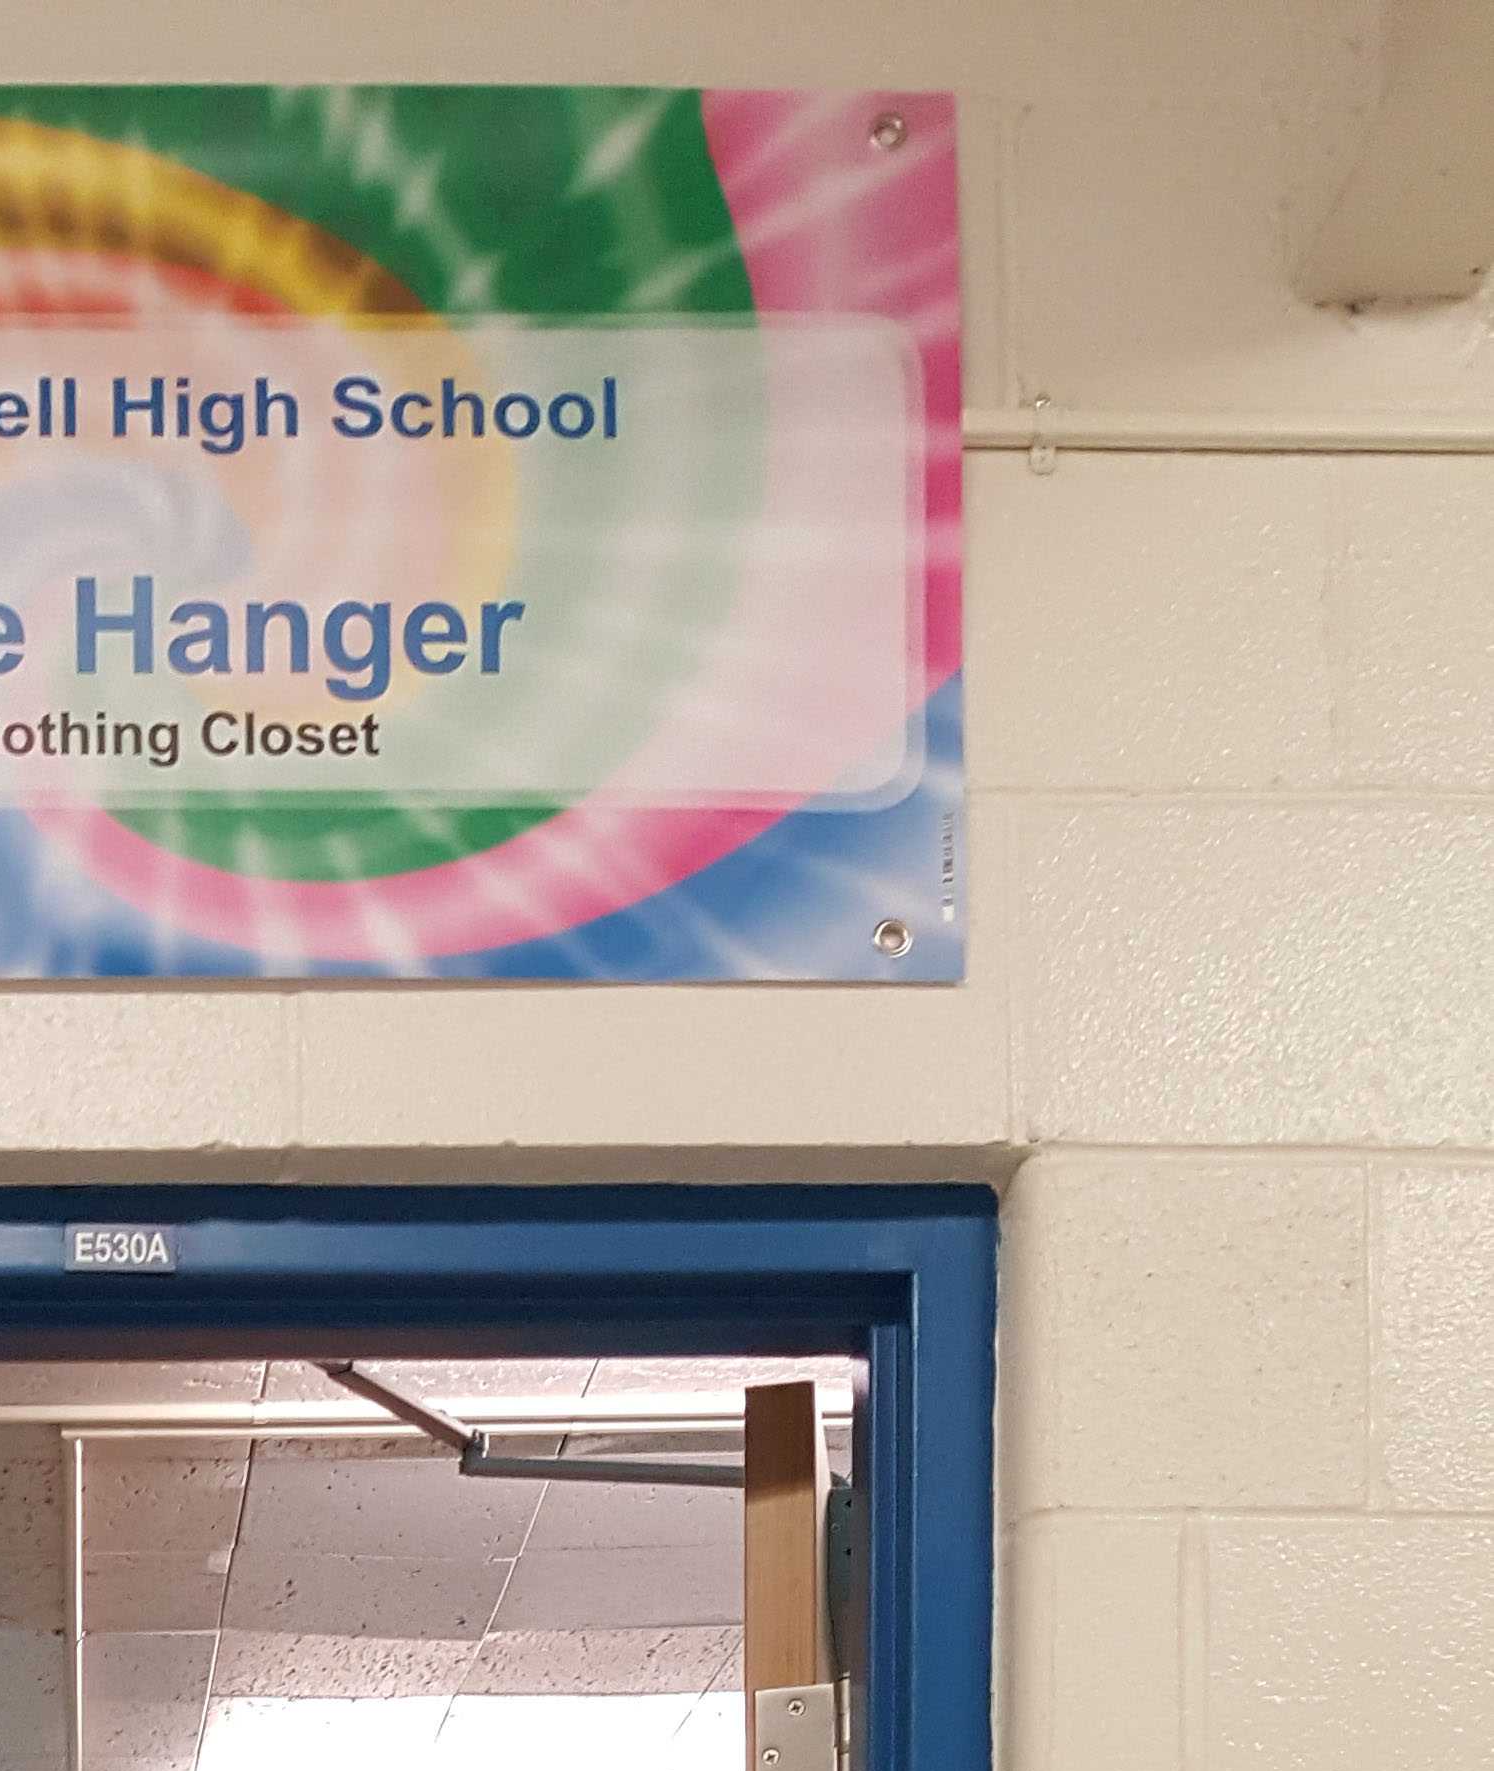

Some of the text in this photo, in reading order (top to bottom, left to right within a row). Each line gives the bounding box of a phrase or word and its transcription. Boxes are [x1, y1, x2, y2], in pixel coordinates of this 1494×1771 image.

[112, 376, 299, 455] High
[332, 375, 618, 441] School
[76, 575, 527, 701] Hanger
[201, 711, 381, 757] Closet
[74, 1231, 169, 1264] E530A
